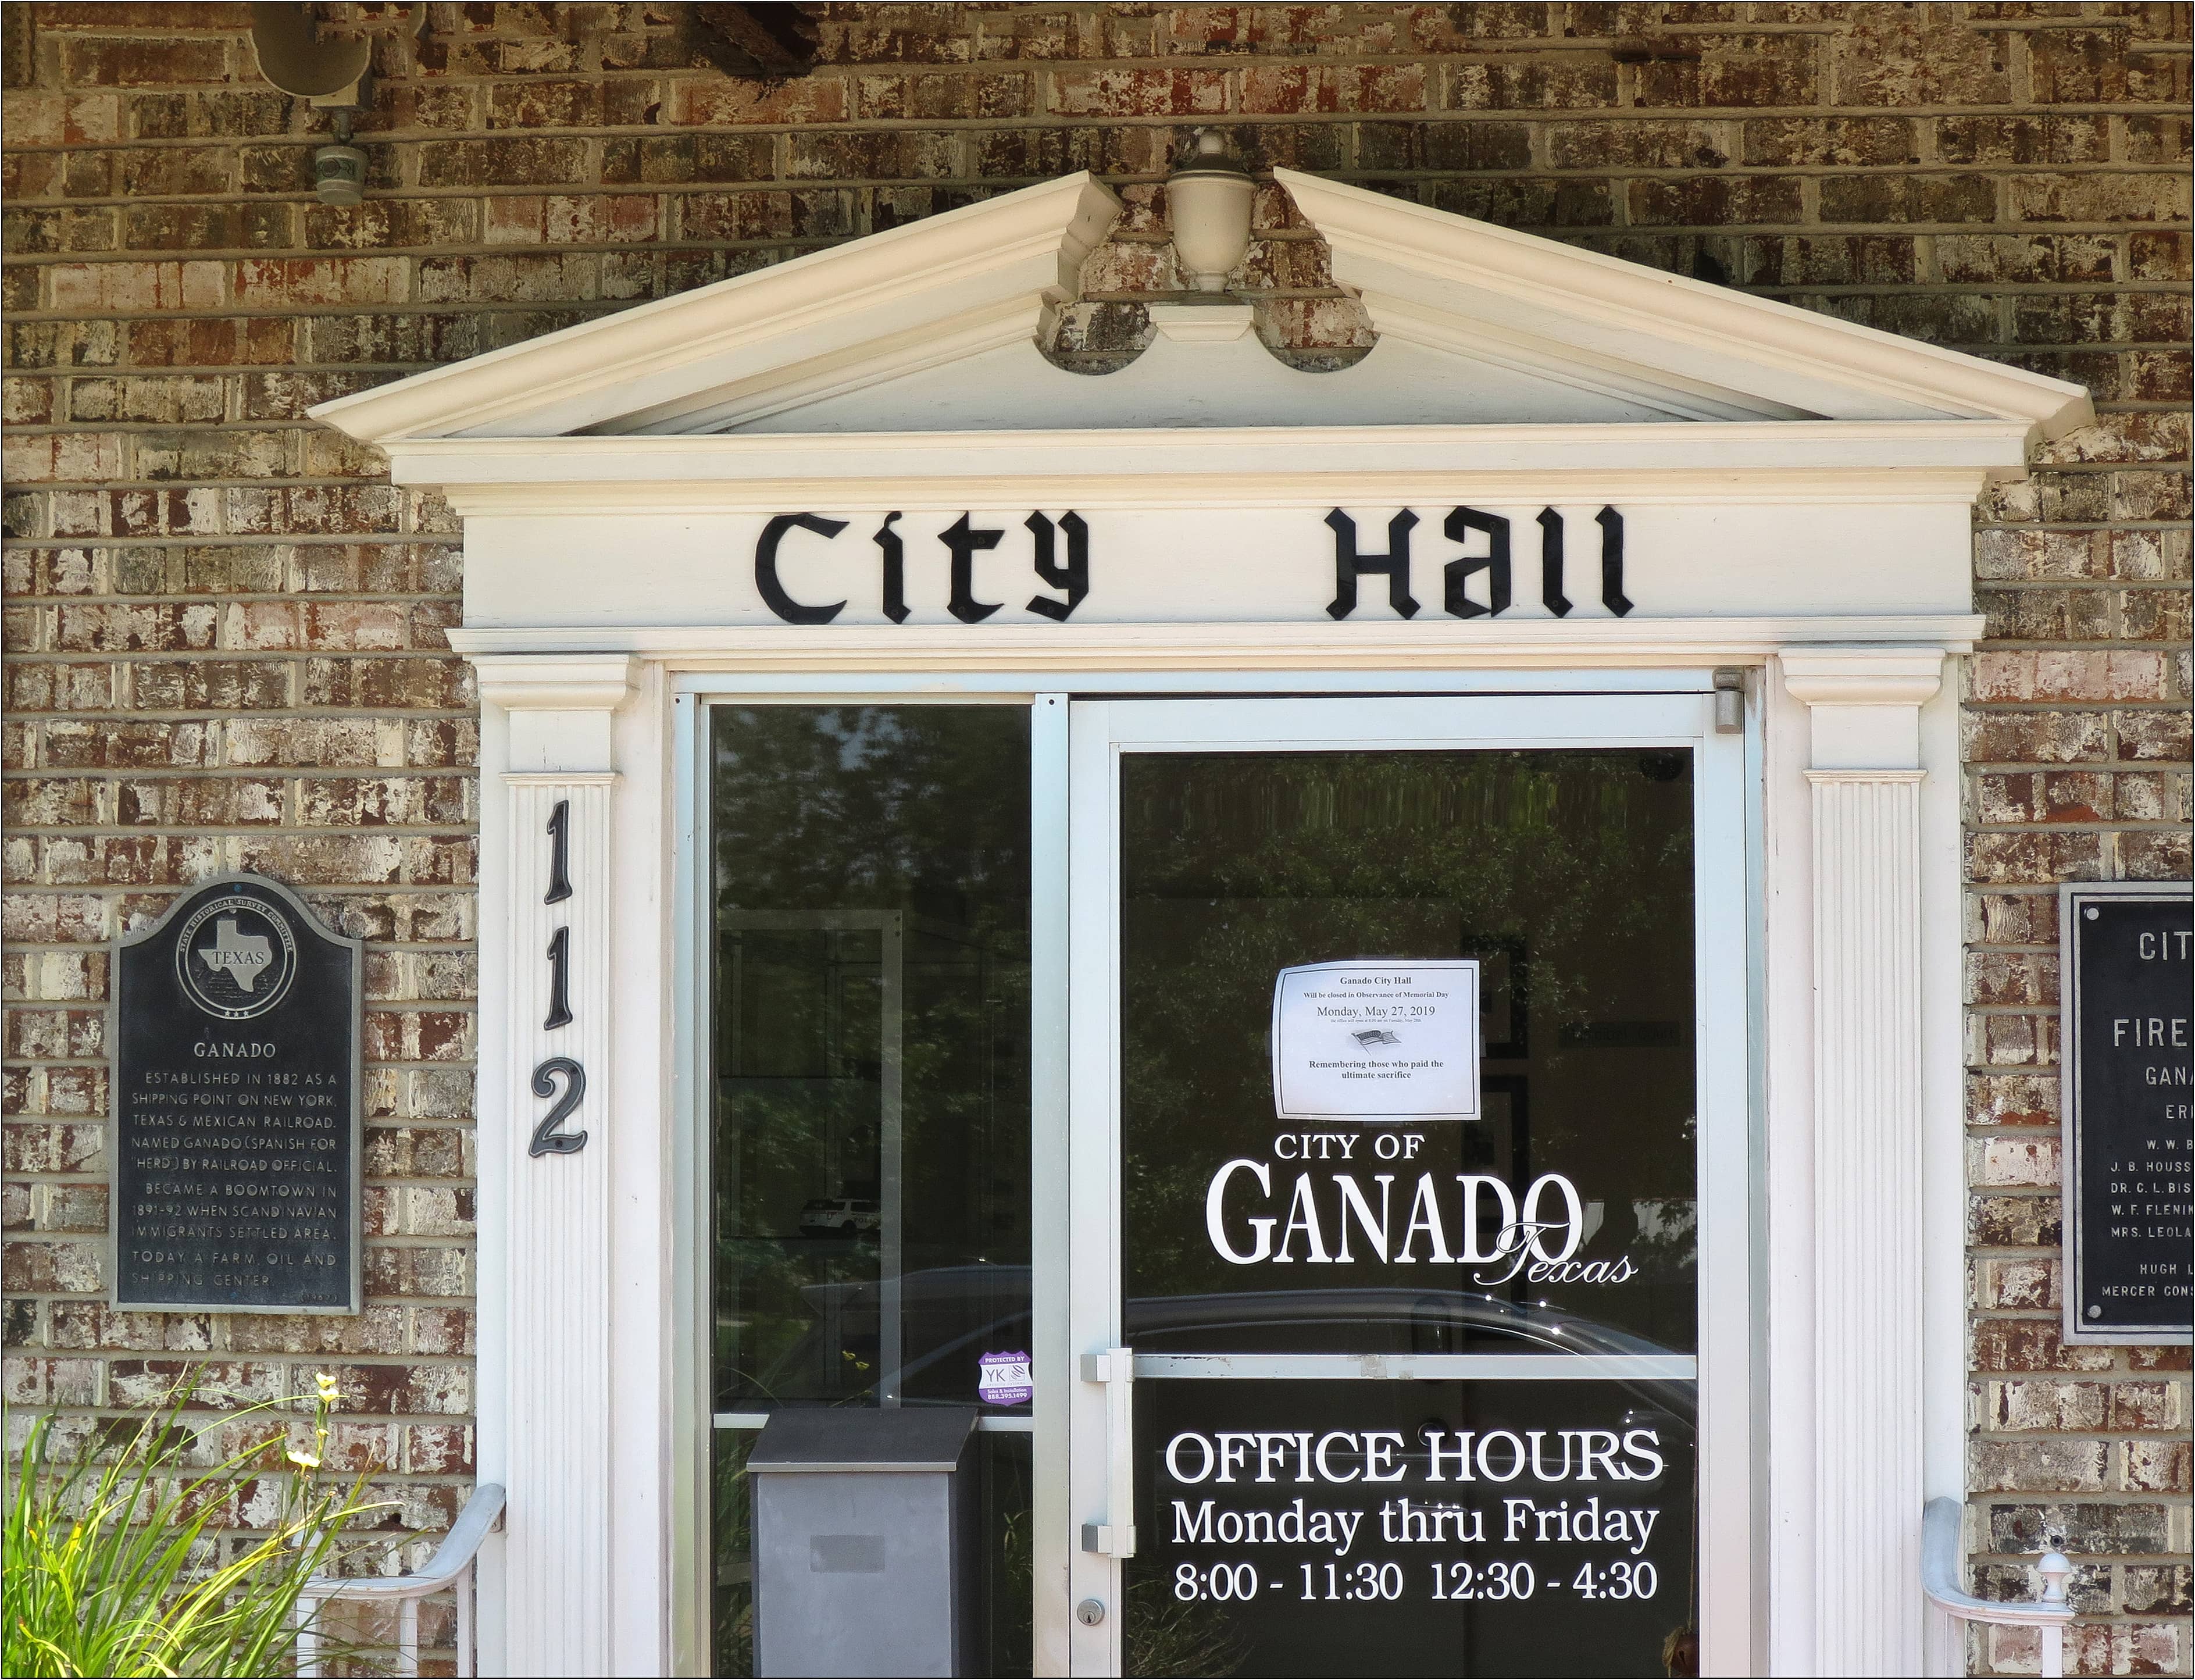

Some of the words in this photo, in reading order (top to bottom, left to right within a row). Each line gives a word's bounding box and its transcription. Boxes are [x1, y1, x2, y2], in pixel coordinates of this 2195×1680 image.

[755, 511, 1089, 624] City
[1324, 506, 1634, 620] Hall
[190, 900, 233, 927] HISTORICAL
[237, 900, 267, 912] SURVEY
[268, 912, 293, 953] COMMITTEE
[2139, 931, 2193, 961] CIT
[212, 951, 263, 964] TEXAS
[529, 800, 587, 1158] 112
[1374, 977, 1391, 986] City
[1317, 1007, 1362, 1018] Monday,
[1365, 1007, 1388, 1018] May
[1391, 1006, 1407, 1017] 27,
[1411, 1006, 1435, 1016] 2019
[2114, 1018, 2188, 1047] FIRE
[194, 1042, 276, 1058] GANADO
[1309, 1060, 1366, 1069] Remembering
[1411, 1061, 1429, 1069] paid
[145, 1073, 240, 1085] ESTABLISHED
[247, 1073, 261, 1084] IN
[267, 1073, 298, 1085] 1882
[305, 1074, 320, 1085] AS
[329, 1074, 337, 1085] A
[132, 1093, 188, 1105] SHIPPING
[194, 1094, 231, 1105] POINT
[238, 1094, 258, 1105] ON
[265, 1095, 291, 1106] NEW
[298, 1096, 337, 1107] YORK,
[2166, 1104, 2193, 1119] ER
[134, 1115, 173, 1126] TEXAS
[179, 1115, 187, 1126] &
[193, 1116, 256, 1127] MEXICAN
[264, 1117, 336, 1128] RAILROAD.
[131, 1137, 179, 1148] NAMED
[184, 1137, 242, 1150] GANADO
[244, 1136, 305, 1150] (SPANISH
[310, 1139, 336, 1151] FOR
[1274, 1134, 1360, 1160] CITY
[1373, 1134, 1425, 1160] OF
[2147, 1140, 2160, 1150] W.
[2166, 1140, 2179, 1150] W.
[184, 1159, 197, 1171] BY
[202, 1159, 267, 1171] RAILROAD
[272, 1160, 337, 1172] OFFICIAL.
[2111, 1162, 2120, 1172] J.
[2129, 1162, 2138, 1172] B.
[2146, 1162, 2191, 1172] HOUSS
[146, 1183, 202, 1196] BECAME
[210, 1185, 219, 1196] A
[226, 1184, 315, 1197] BOOMTOWN
[323, 1186, 337, 1197] IN
[2111, 1183, 2130, 1193] DR.
[2137, 1183, 2147, 1193] C.
[132, 1205, 181, 1217] 1891-92
[187, 1206, 227, 1217] WHEN
[233, 1206, 337, 1218] SCANDINAVIAN
[1205, 1158, 1584, 1266] GANADO
[2111, 1205, 2125, 1215] W.
[2130, 1205, 2139, 1215] F.
[131, 1226, 223, 1238] IMMIGRANTS
[229, 1228, 287, 1239] SETTLED
[294, 1229, 337, 1240] AREA.
[2111, 1227, 2142, 1238] MRS.
[2148, 1227, 2192, 1238] LEOLA
[133, 1251, 185, 1263] TODAY
[194, 1253, 204, 1263] A
[266, 1253, 294, 1265] OIL
[304, 1254, 336, 1266] AND
[1473, 1222, 1639, 1286] Texas
[2140, 1264, 2178, 1275] HUGH
[132, 1273, 204, 1286] SHIPPING
[2102, 1286, 2155, 1296] MERCER
[986, 1369, 1005, 1382] YK
[1165, 1432, 1408, 1484] OFFICE
[1425, 1429, 1664, 1483] HOURS
[1170, 1499, 1364, 1556] Monday
[1380, 1497, 1487, 1543] thru
[1504, 1497, 1660, 1555] Friday
[1173, 1564, 1258, 1601] 8:00
[1300, 1563, 1404, 1601] 11:30
[1430, 1562, 1535, 1600] 12:30
[1572, 1561, 1658, 1600] 4:30
